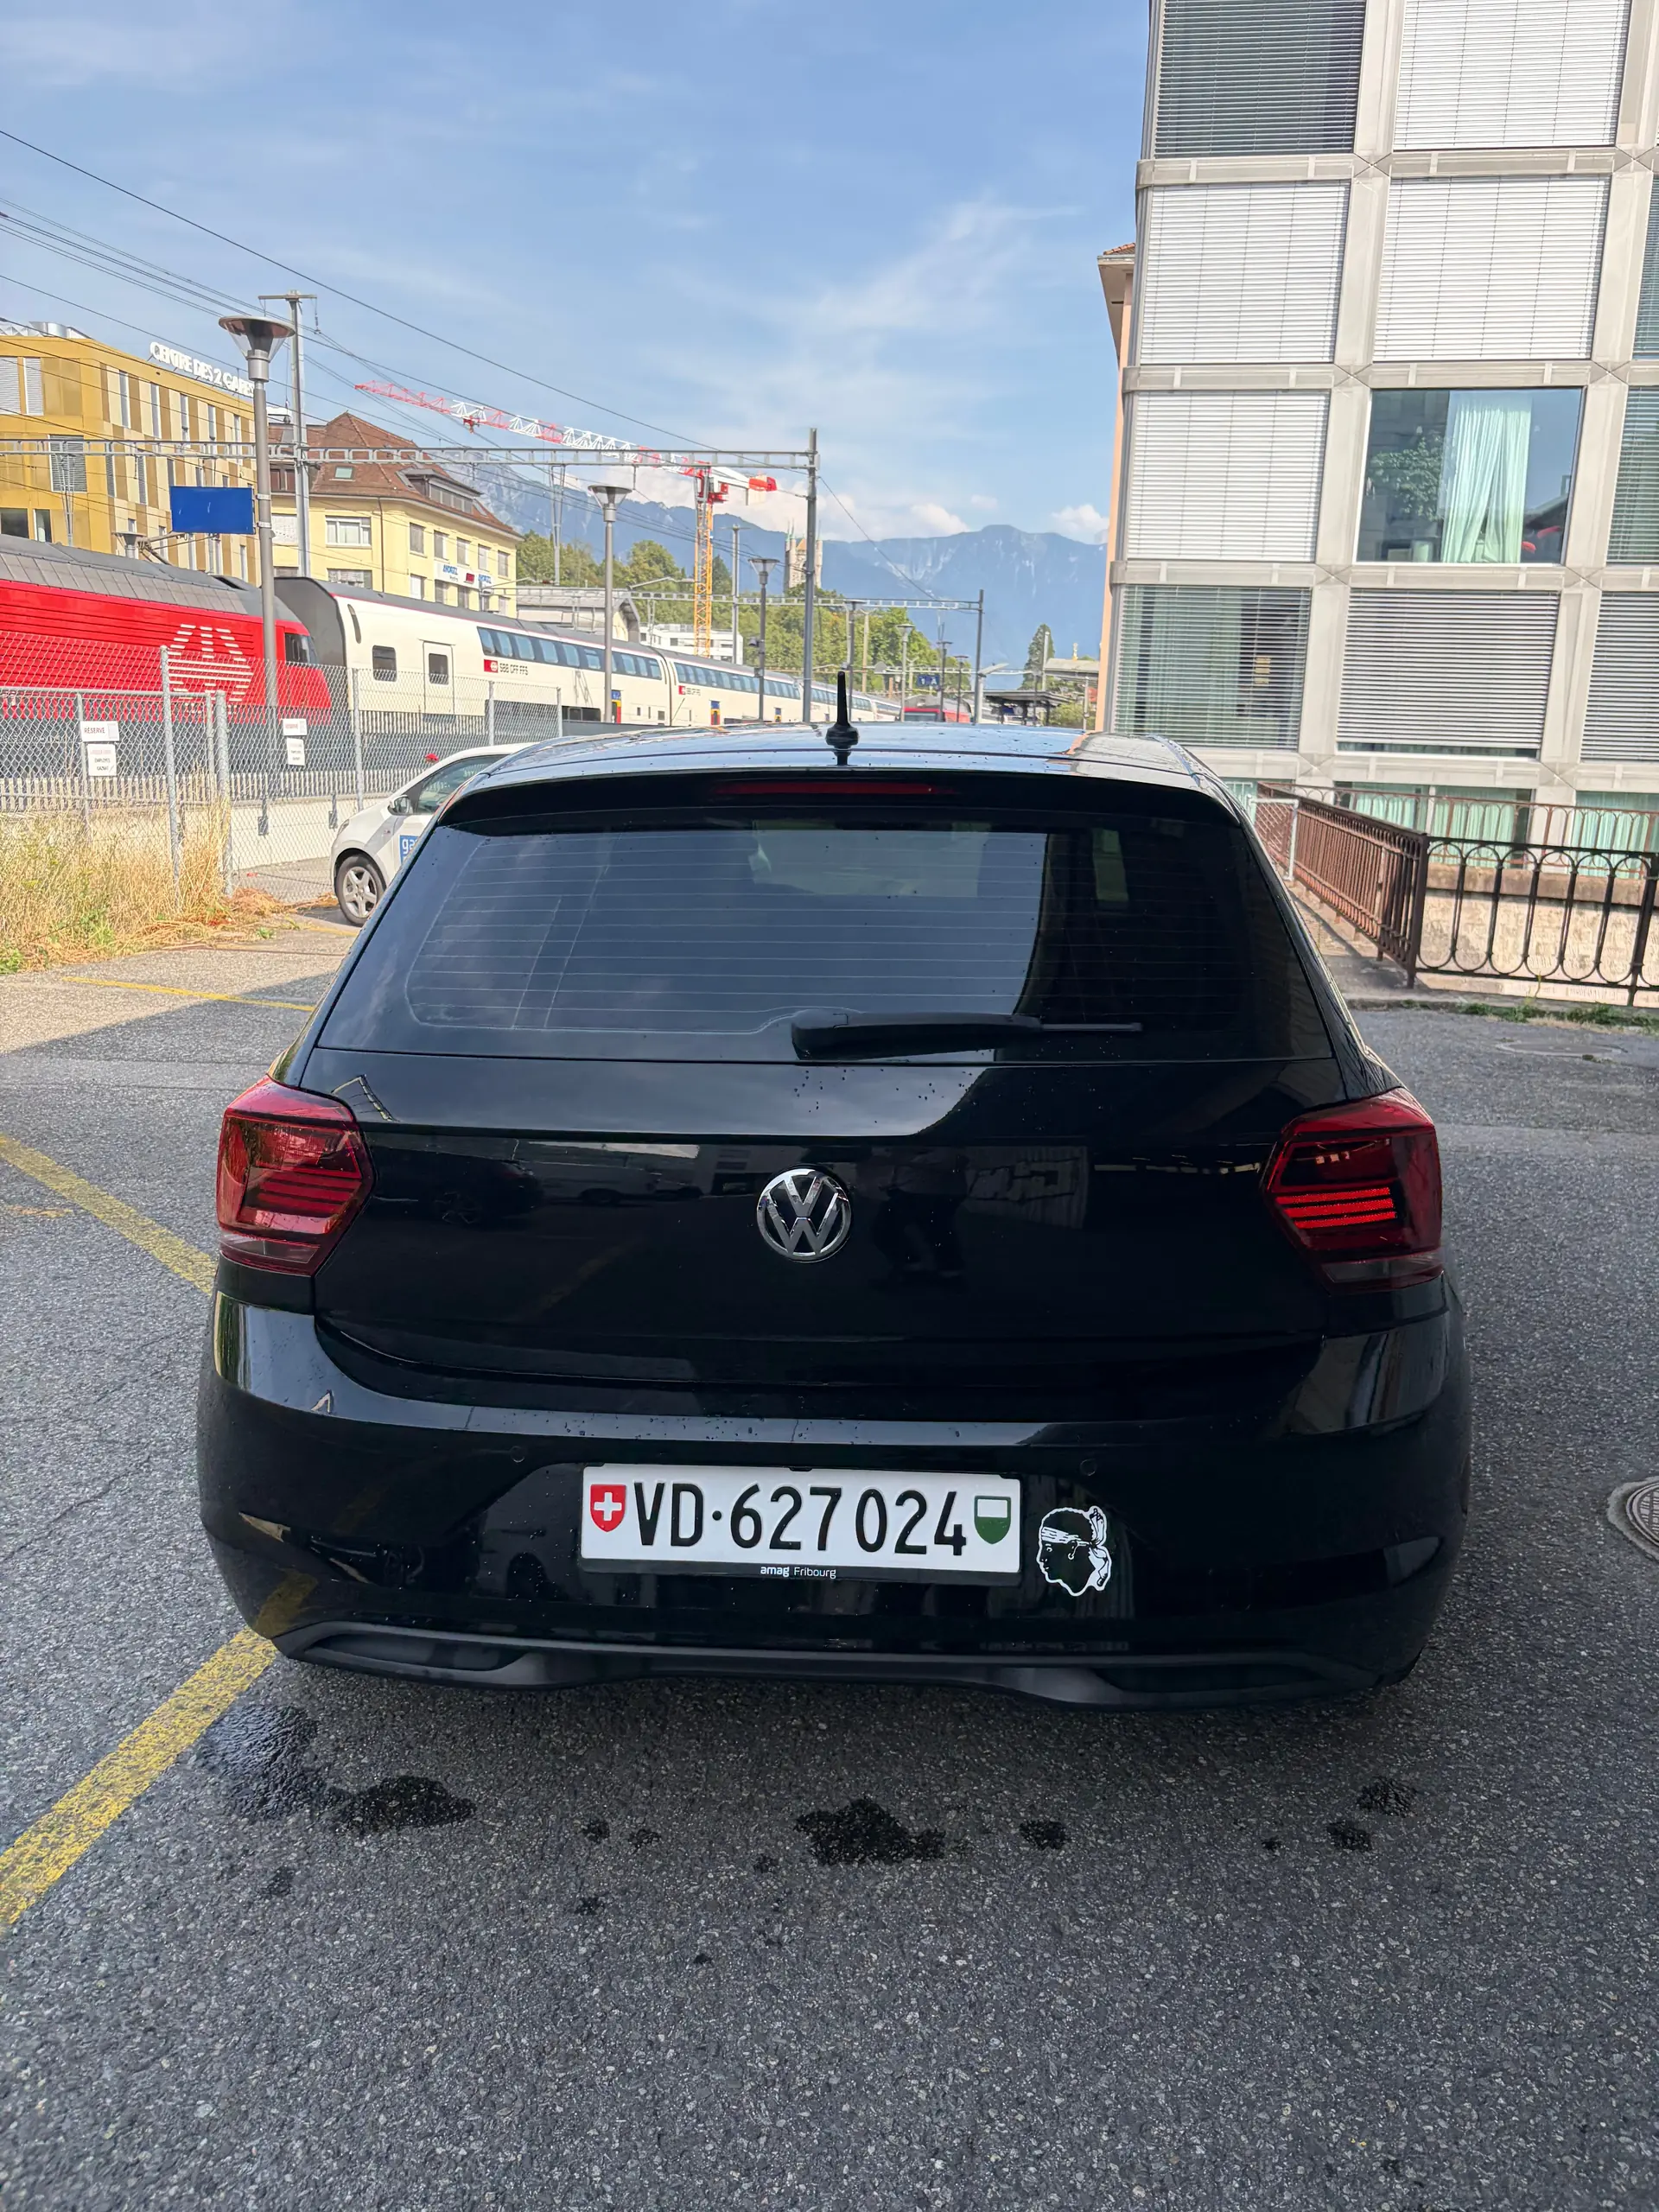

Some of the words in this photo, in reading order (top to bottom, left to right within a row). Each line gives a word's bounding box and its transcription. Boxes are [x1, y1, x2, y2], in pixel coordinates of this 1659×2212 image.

[149, 341, 193, 372] CENTRE
[193, 359, 213, 383] DES
[213, 368, 222, 386] 2
[760, 1566, 790, 1578] amag
[793, 1567, 836, 1580] Fribourg
